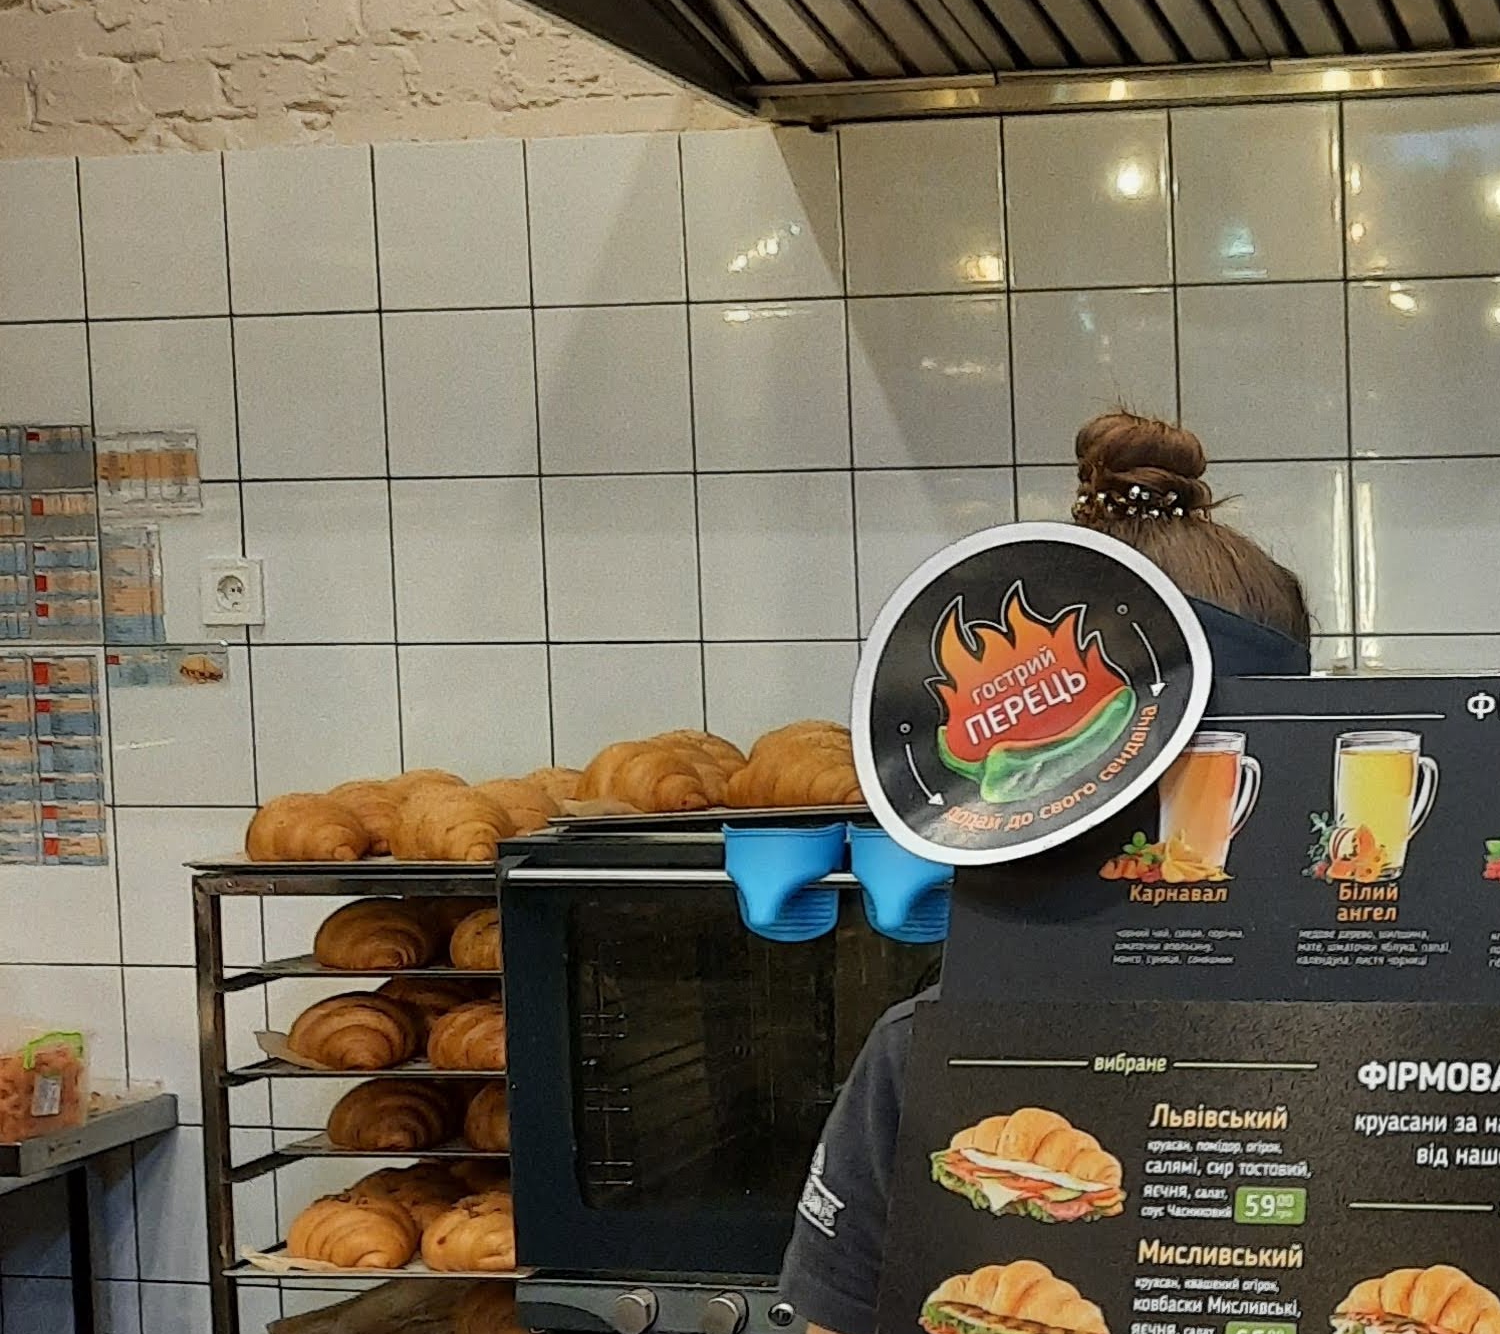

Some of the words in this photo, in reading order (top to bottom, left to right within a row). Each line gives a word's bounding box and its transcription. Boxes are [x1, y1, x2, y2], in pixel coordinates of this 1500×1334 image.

[970, 645, 1057, 707] гострий
[963, 668, 1087, 746] ПЕРЕЦЬ
[1008, 812, 1034, 831] до
[1039, 782, 1097, 820] свого
[1099, 703, 1158, 782] сендвіча
[1129, 884, 1228, 906] Карнавал
[1337, 881, 1399, 904] Білий
[1336, 902, 1397, 925] ангел
[1094, 1055, 1167, 1073] вибране
[1150, 1103, 1287, 1130] Львівський
[1354, 1113, 1447, 1135] круасани
[1454, 1117, 1477, 1133] за
[1145, 1158, 1202, 1177] салямі,
[1207, 1160, 1234, 1178] сир
[1240, 1160, 1312, 1178] тостовий,
[1416, 1146, 1448, 1167] від
[1138, 1238, 1303, 1268] Мисливський
[1133, 1296, 1202, 1313] ковбаски
[1207, 1297, 1302, 1316] Мисливські,
